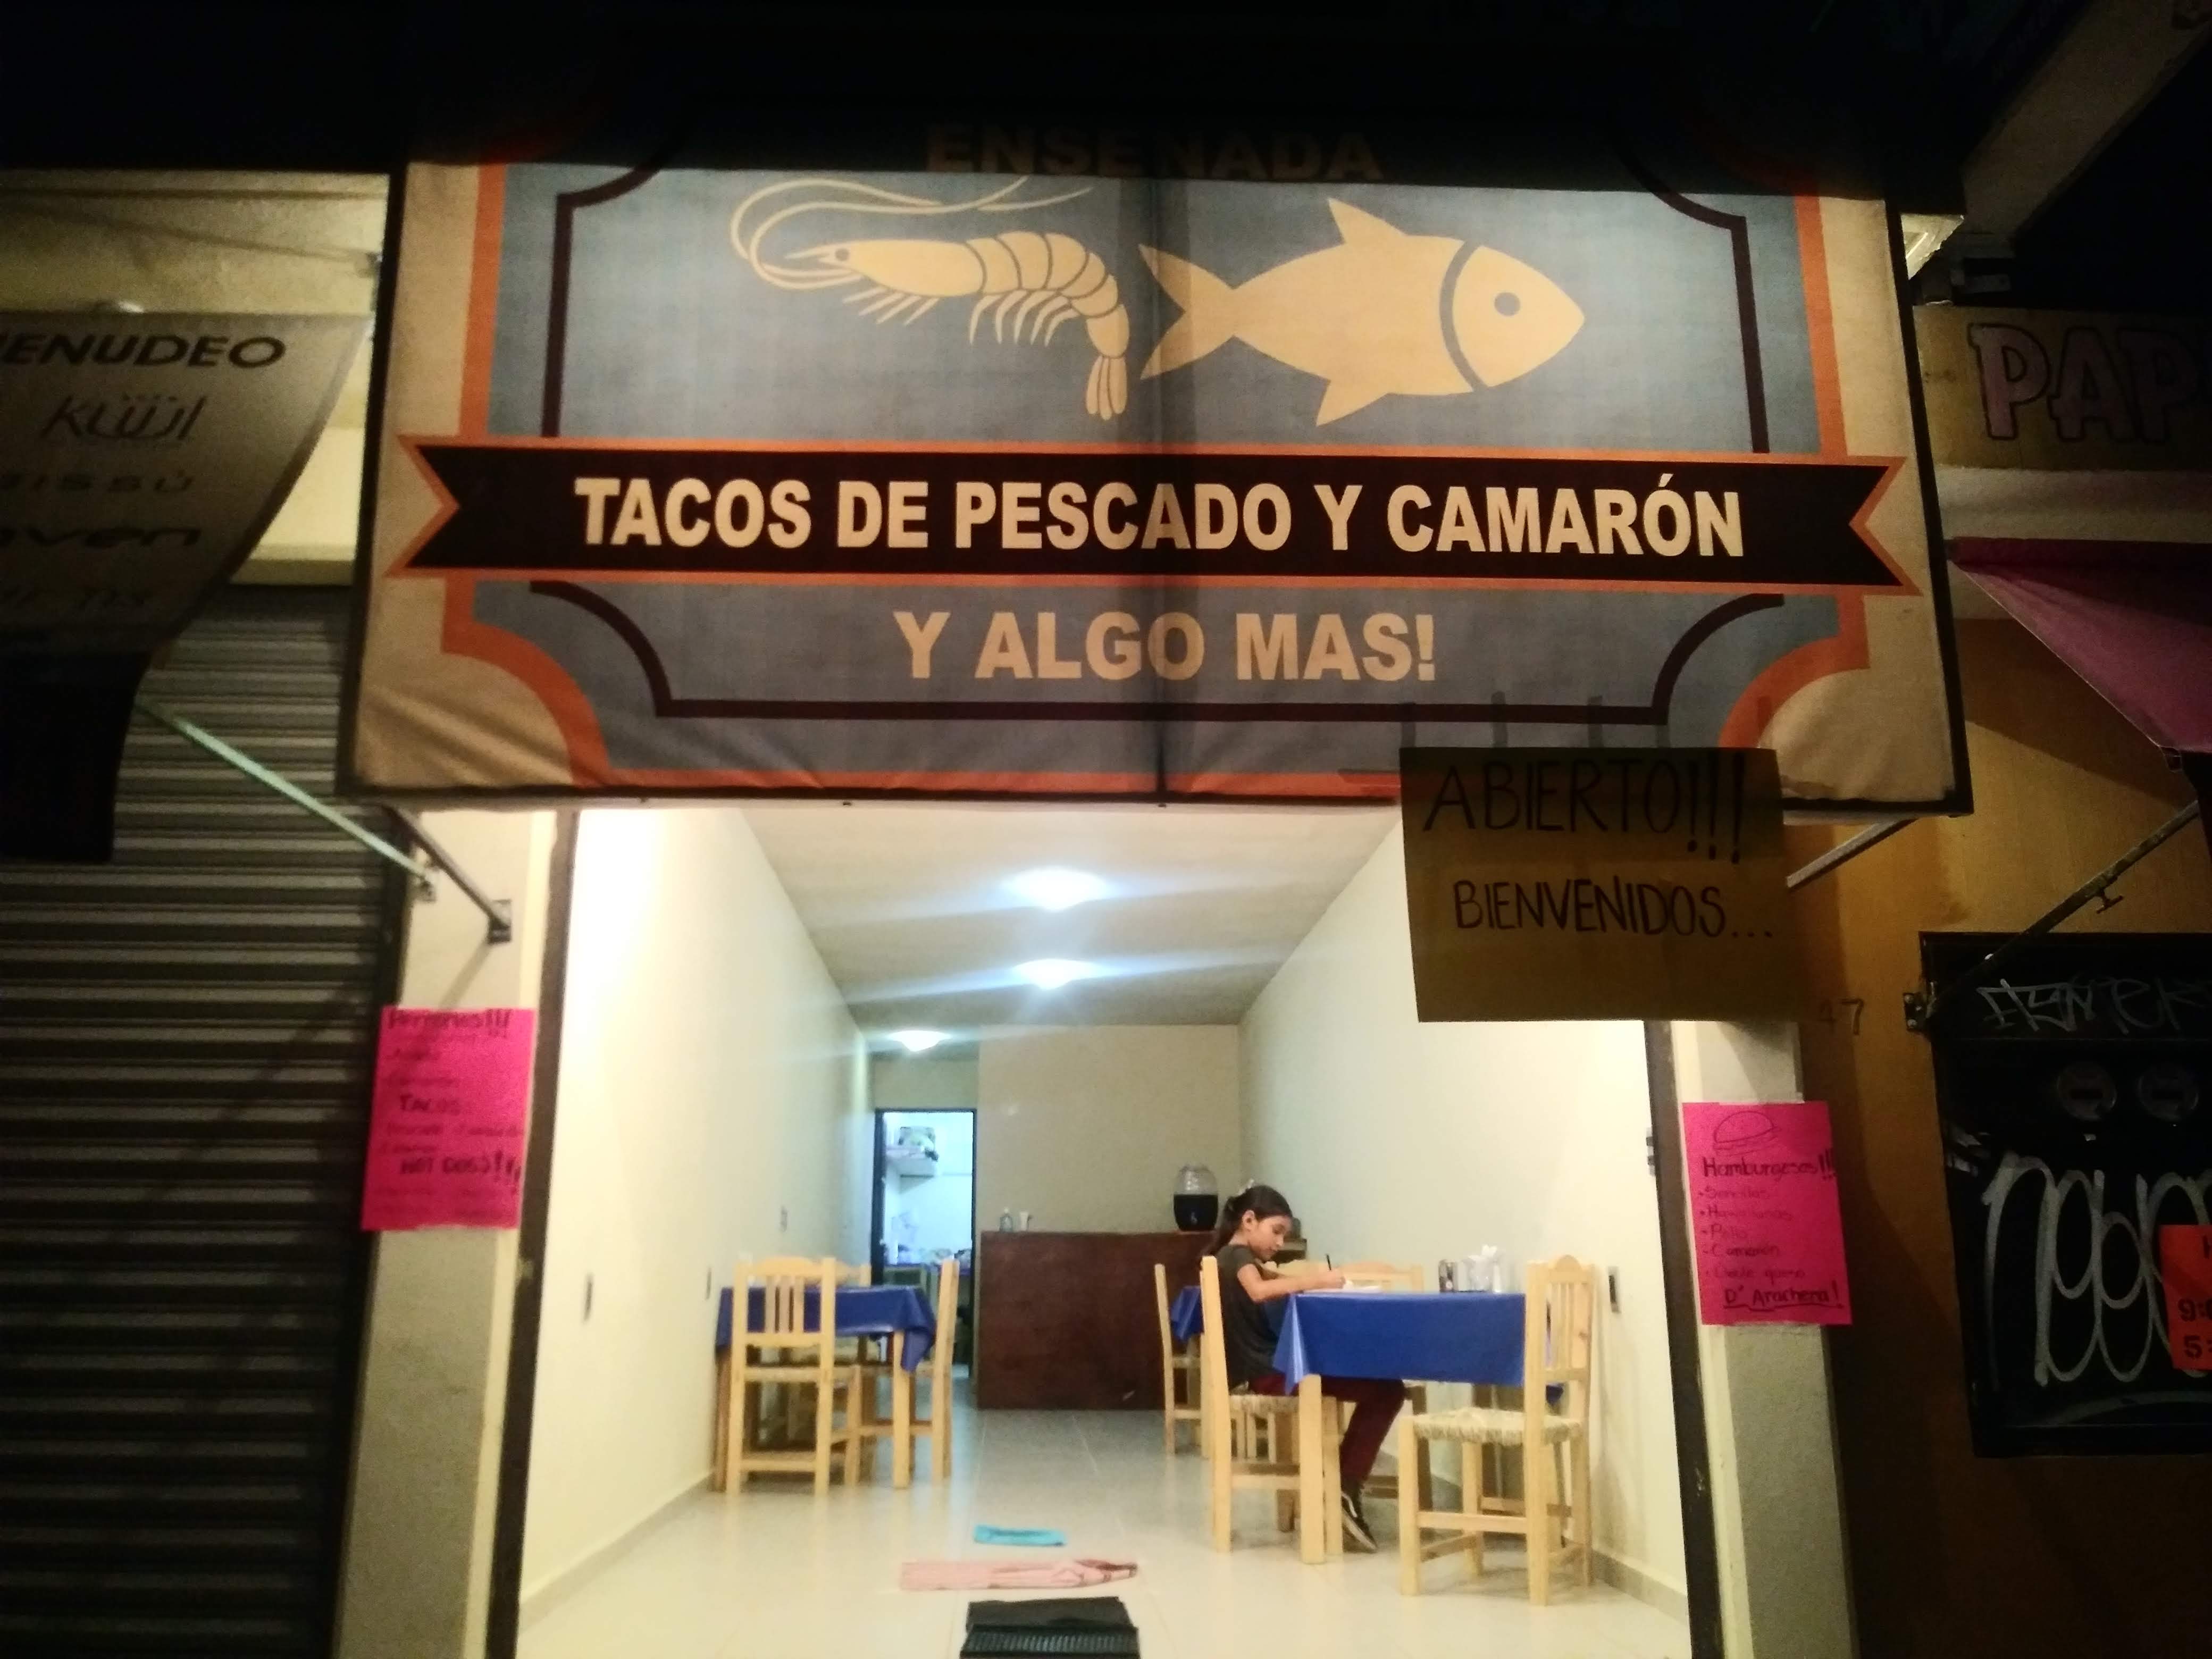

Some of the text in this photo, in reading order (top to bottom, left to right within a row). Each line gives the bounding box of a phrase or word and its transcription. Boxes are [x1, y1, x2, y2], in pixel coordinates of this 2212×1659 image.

[924, 122, 1382, 182] ENSENADA
[0, 332, 286, 369] ENUDEO
[574, 473, 1744, 557] TACOS DE PESCADO Y CAMARÓN
[893, 611, 1437, 683] Y ALGO MAS!
[1423, 752, 1745, 864] ABIERTO!!!
